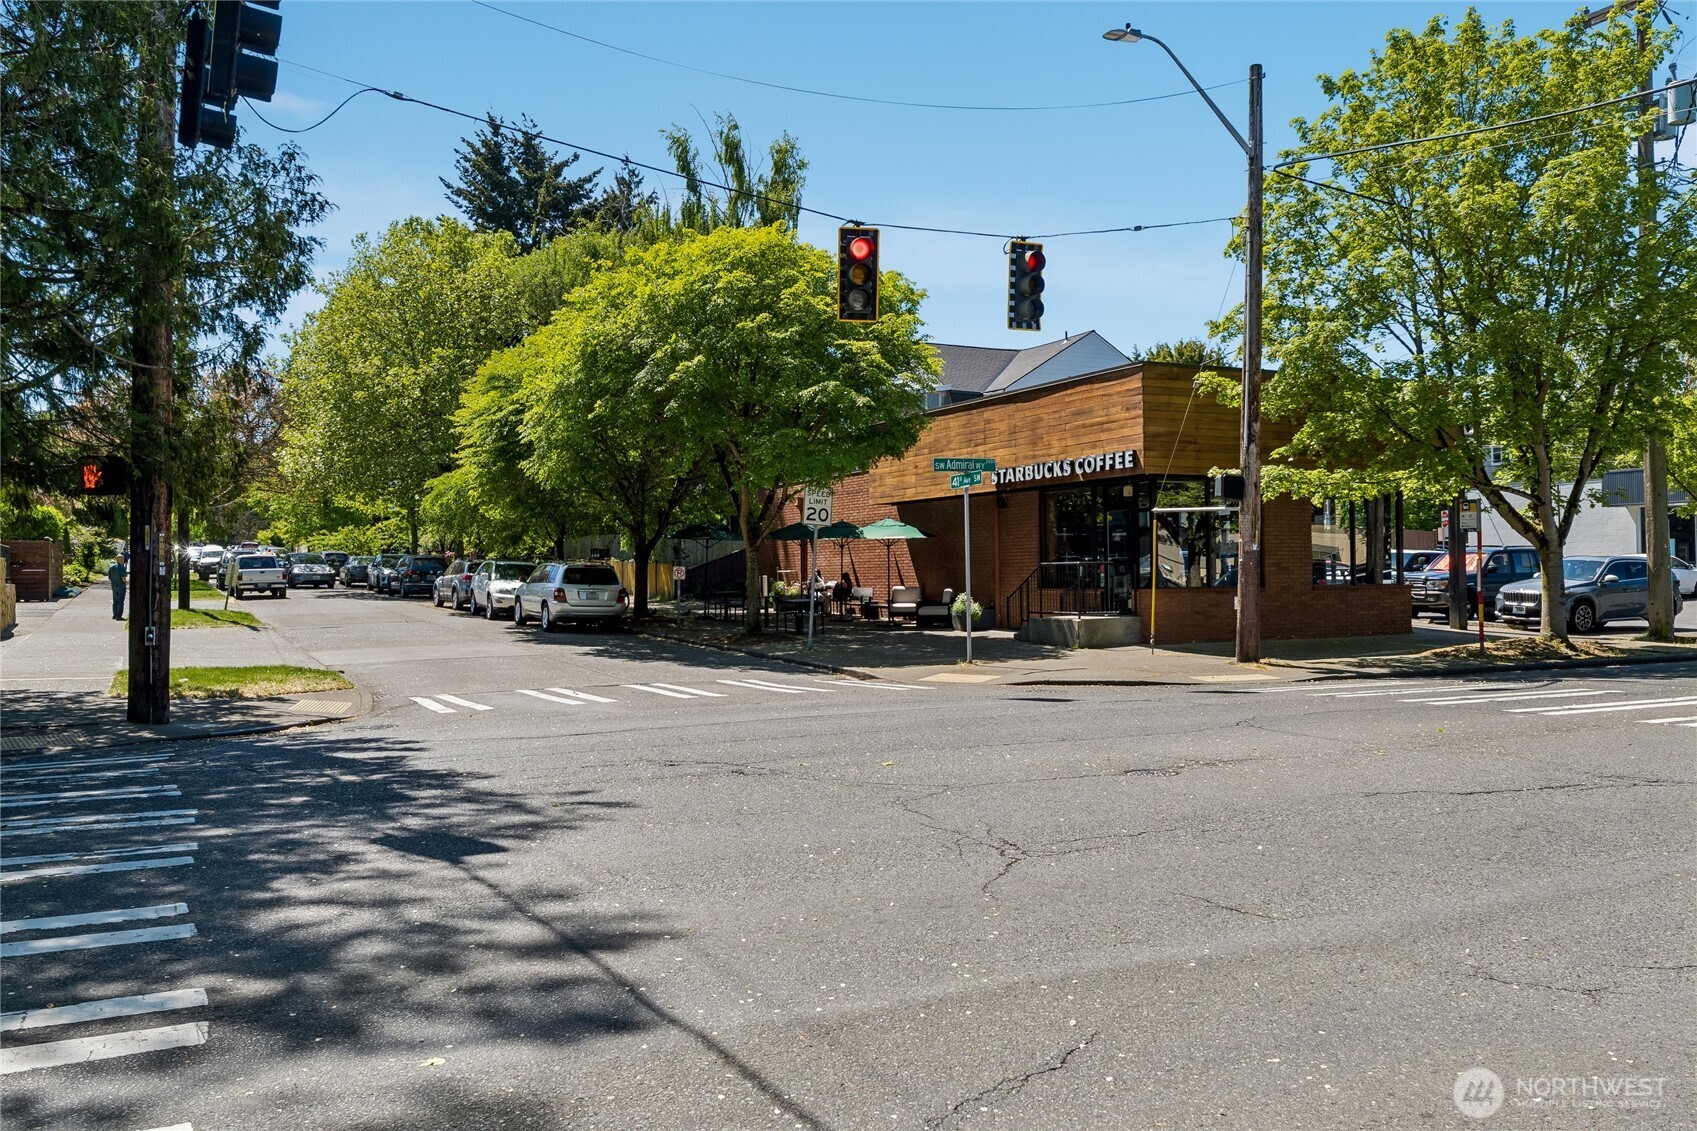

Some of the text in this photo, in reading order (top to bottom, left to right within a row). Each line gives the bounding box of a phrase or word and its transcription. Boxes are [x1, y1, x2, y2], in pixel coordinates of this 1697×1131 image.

[934, 462, 945, 470] SW
[946, 459, 975, 470] Admiral
[991, 450, 1134, 485] STARBUCKS COFFEE
[973, 474, 981, 482] SW
[807, 489, 831, 498] SPEED
[809, 498, 828, 506] LIMIT
[806, 507, 829, 522] 20
